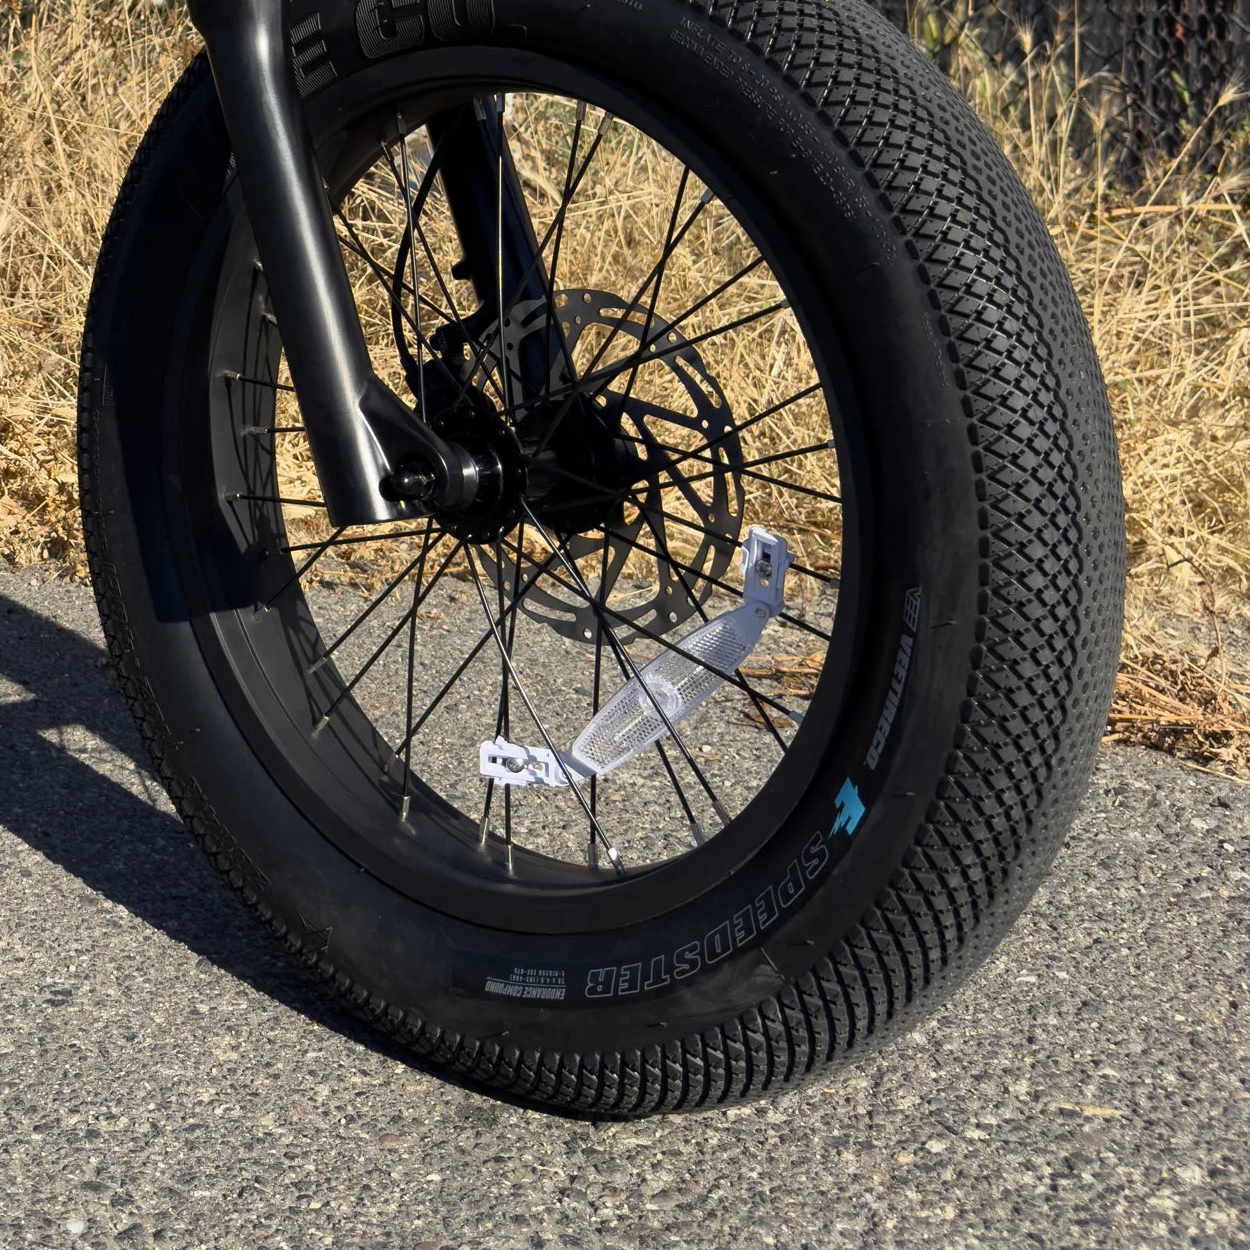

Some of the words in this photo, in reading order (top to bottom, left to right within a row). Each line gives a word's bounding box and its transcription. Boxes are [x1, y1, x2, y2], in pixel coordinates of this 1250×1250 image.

[584, 831, 830, 998] SPEEDSTER
[484, 980, 523, 998] COMPOUND
[522, 985, 566, 1000] ENDURANCE
